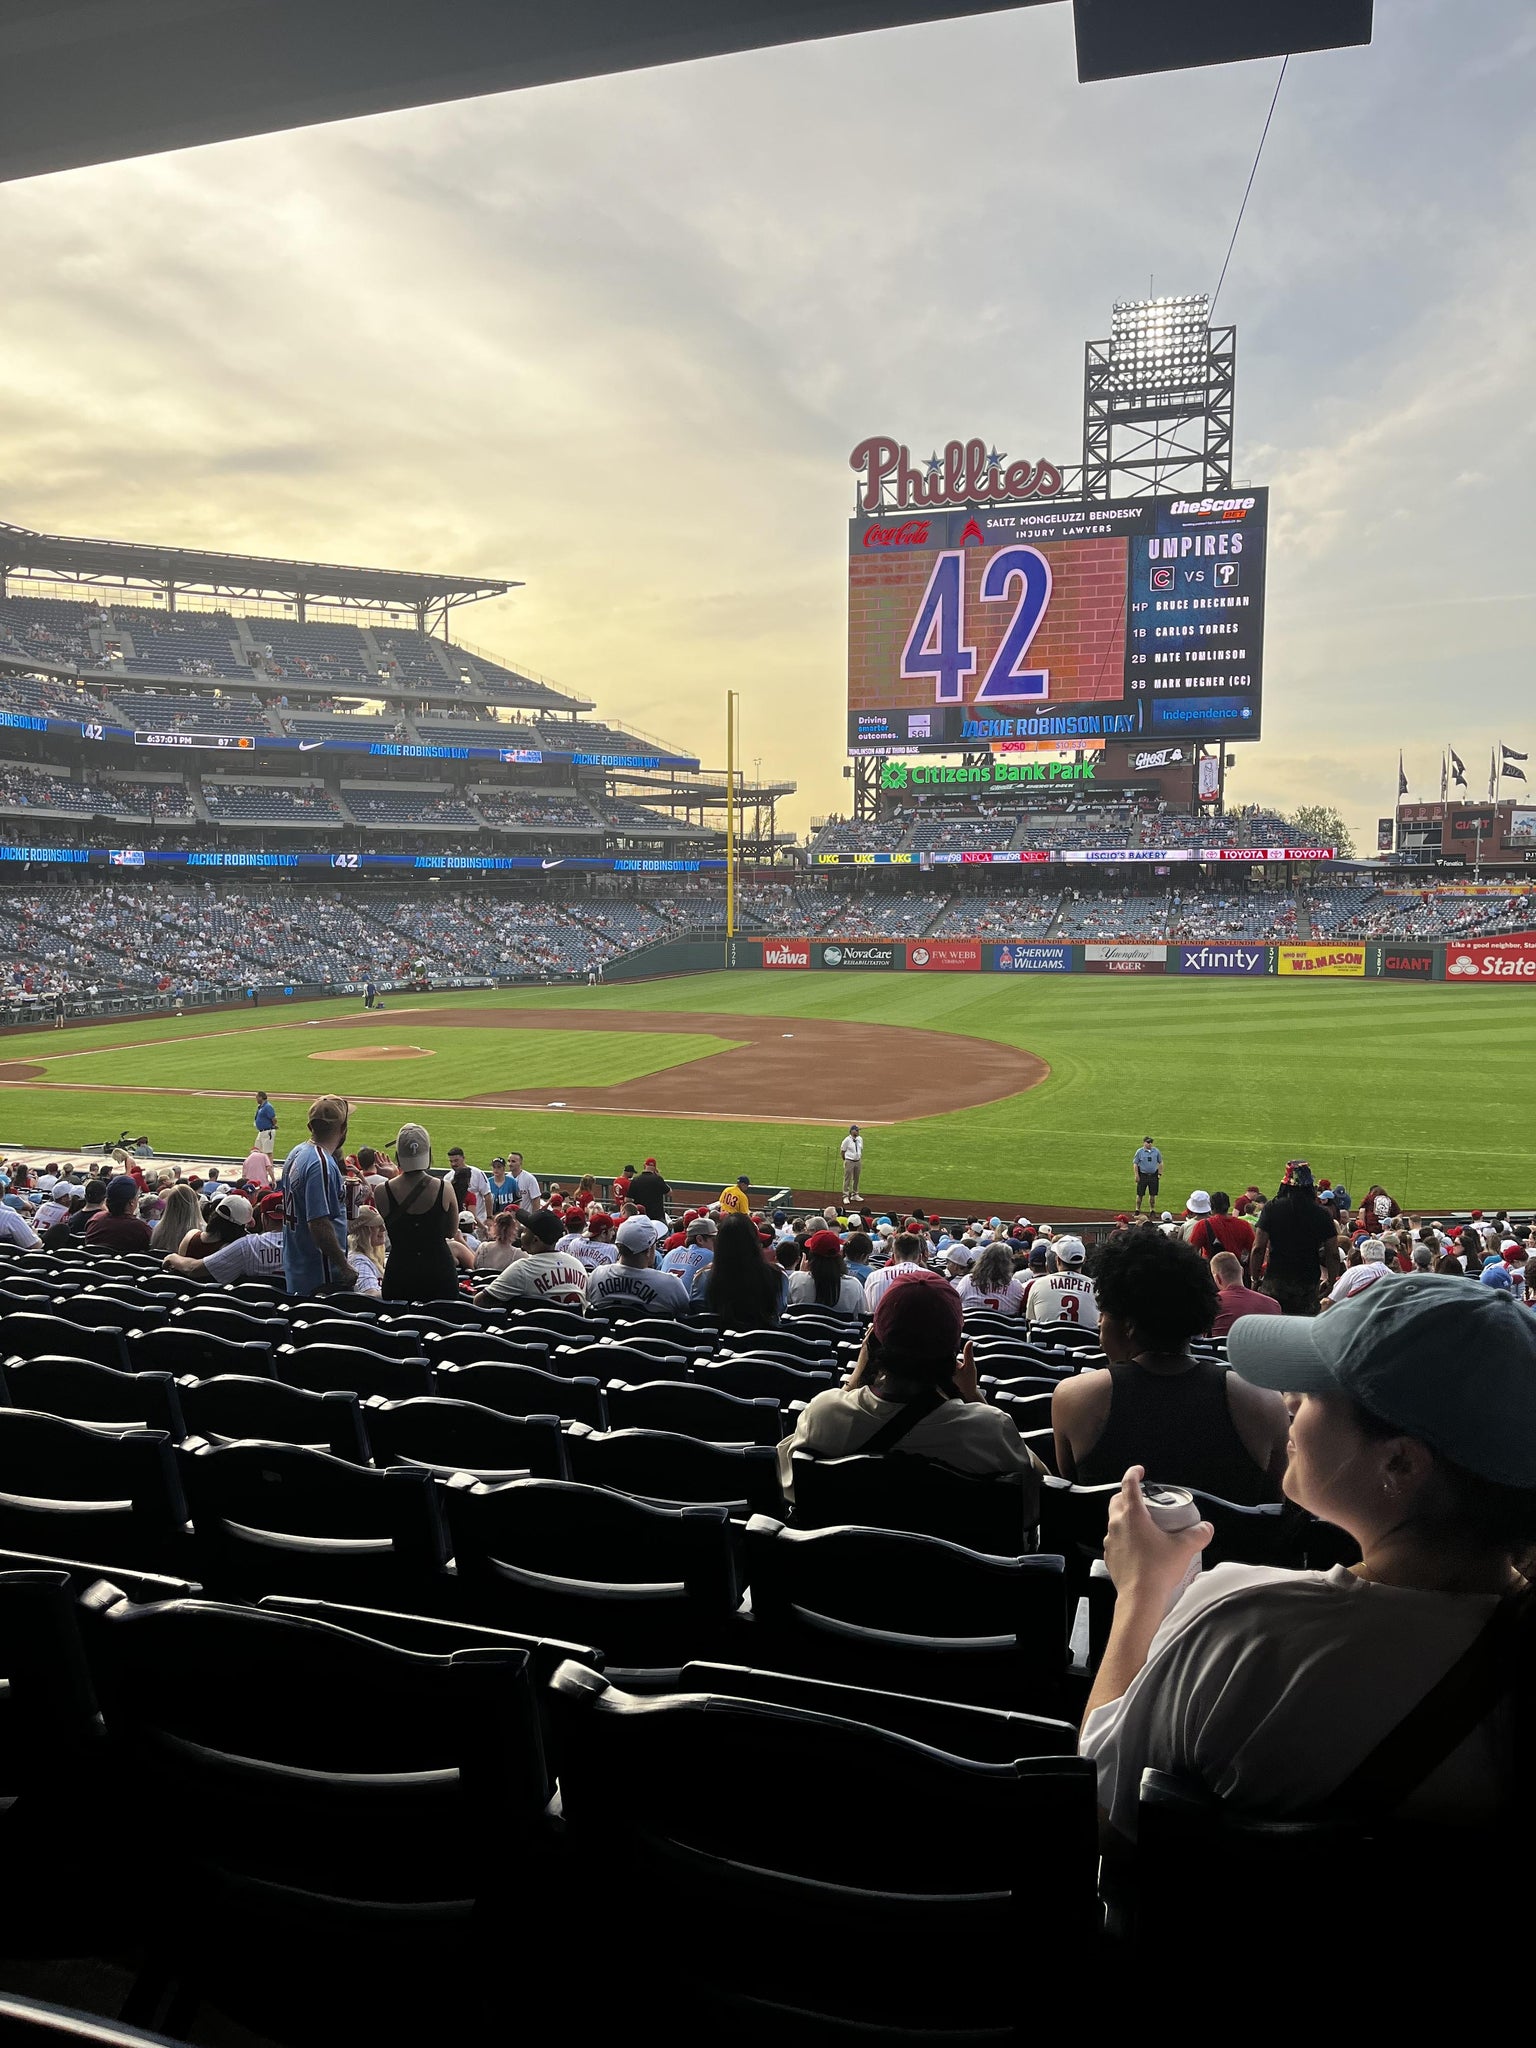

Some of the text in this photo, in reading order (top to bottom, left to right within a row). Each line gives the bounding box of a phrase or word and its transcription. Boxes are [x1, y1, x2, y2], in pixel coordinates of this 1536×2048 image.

[849, 436, 1062, 510] Phillies
[1170, 497, 1255, 515] theScore
[986, 508, 1143, 528] SALTZ MONGELUZZI BENDESKY
[863, 520, 933, 547] Coca-Cola
[1016, 524, 1112, 539] INJURY LAWYERS
[1148, 533, 1243, 560] UMPIRES
[1184, 570, 1205, 582] VS
[1132, 596, 1250, 612] HP BRUCE DRECKMAN
[900, 544, 1053, 703] 42
[1133, 623, 1239, 638] 1B CARLOS TORRES
[1131, 649, 1246, 664] 2B NATE TOMLINSON
[1131, 675, 1251, 690] 3B MARK WEGNER (CC)
[858, 716, 887, 725] Driving
[1163, 708, 1238, 720] Independence
[85, 724, 103, 740] 42
[960, 714, 1136, 738] JACKIE ROBINSON DAY
[146, 735, 192, 745] 6:37:01 PM
[858, 732, 899, 740] outcomes.
[369, 743, 402, 756] JACKIE
[403, 745, 451, 758] ROBINSON
[572, 753, 601, 765] JACKIE
[601, 755, 644, 767] ROBINSON
[1135, 748, 1174, 769] GHOST
[911, 760, 1096, 784] Citizens Bank Park
[0, 847, 29, 861] JACKIE
[30, 848, 73, 862] ROBINSON
[186, 853, 298, 866] JACKIE ROBINSON DAY
[335, 854, 358, 868] 42
[818, 854, 840, 864] UKG
[853, 854, 875, 864] UKG
[890, 853, 912, 863] UKG
[964, 853, 991, 862] NECA
[1086, 851, 1167, 860] LISCIO'S BAKERY
[1223, 851, 1264, 859] TOYOTA
[1288, 850, 1329, 859] TOYOTA
[414, 857, 446, 868] JACKIE
[447, 857, 494, 868] ROBINSON
[614, 860, 642, 870] JACKIE
[642, 860, 684, 871] ROBINSON
[765, 950, 809, 965] Wawa
[842, 947, 892, 959] NovaCare
[956, 951, 976, 960] WEBB
[1014, 946, 1064, 958] SHERWIN
[1100, 946, 1149, 960] Yuengling
[1185, 945, 1259, 970] xfinity
[1014, 958, 1065, 969] WILLIAMS.
[1109, 962, 1142, 970] LAGER
[1385, 957, 1431, 970] GIANT
[1481, 956, 1536, 975] State
[723, 1193, 738, 1207] 103
[534, 1268, 586, 1294] REALMUTO
[1050, 1278, 1091, 1294] HARPER
[598, 1276, 658, 1304] ROBINSON
[1060, 1295, 1080, 1322] 3
